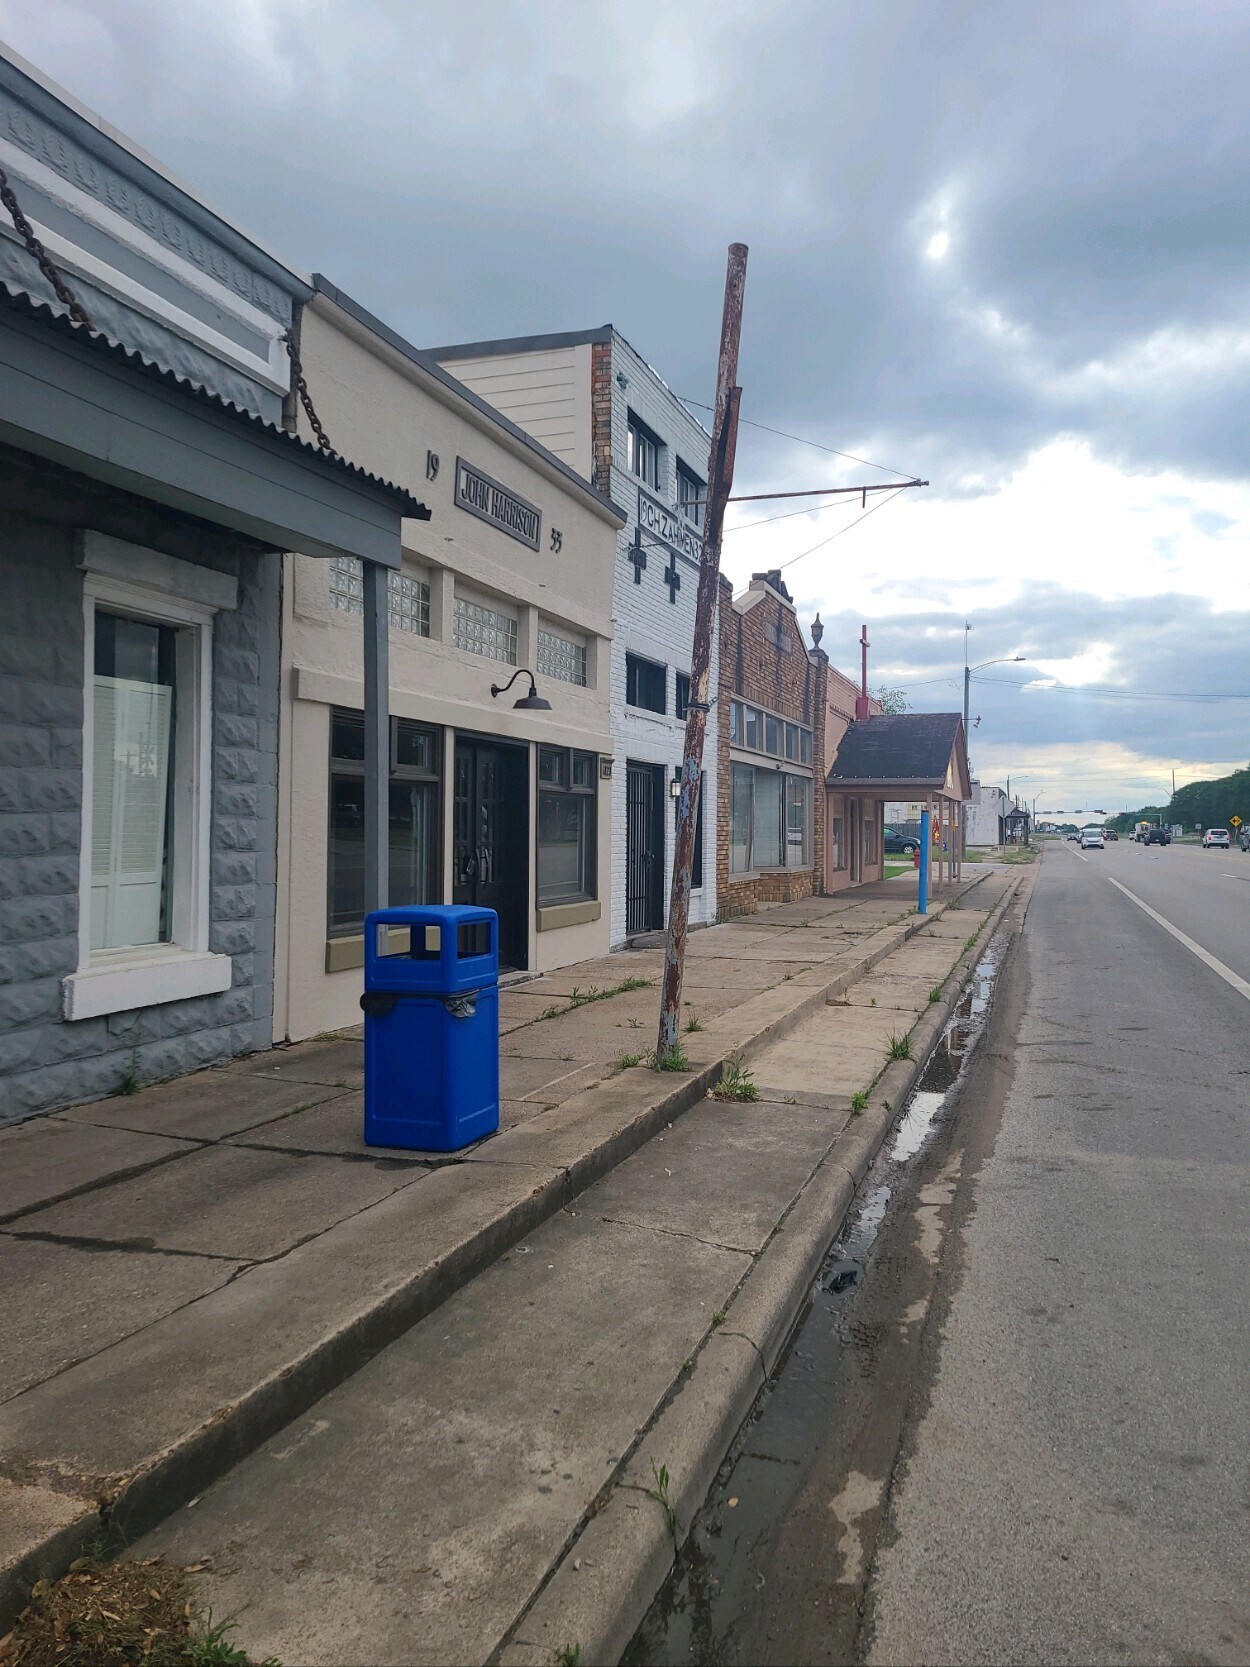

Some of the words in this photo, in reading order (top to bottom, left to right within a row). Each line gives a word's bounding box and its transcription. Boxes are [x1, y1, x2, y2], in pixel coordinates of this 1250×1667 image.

[426, 450, 440, 481] 19
[461, 474, 489, 512] JOHN
[491, 489, 536, 540] HARRISON
